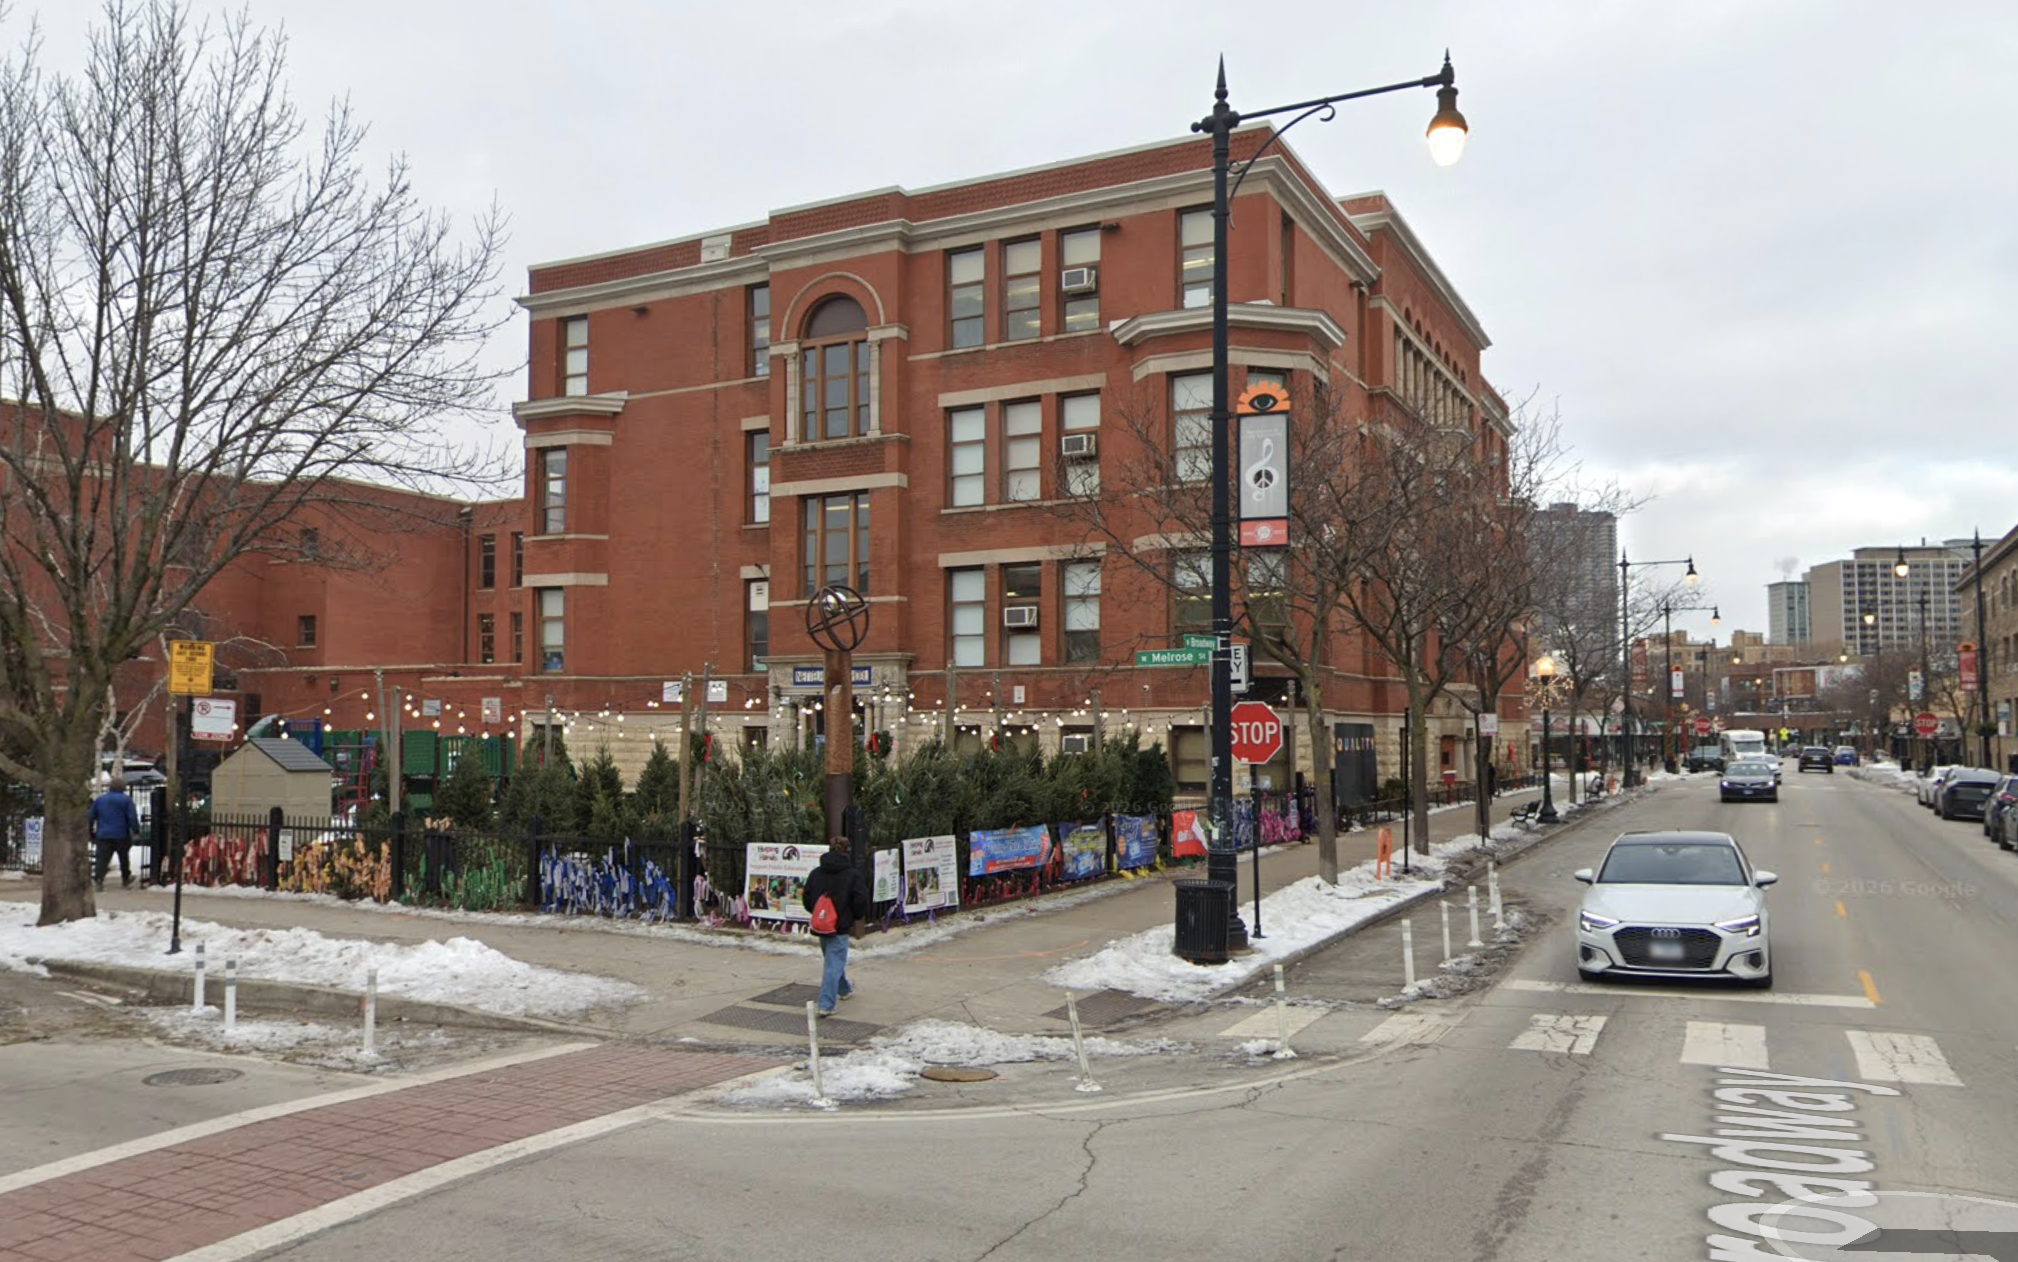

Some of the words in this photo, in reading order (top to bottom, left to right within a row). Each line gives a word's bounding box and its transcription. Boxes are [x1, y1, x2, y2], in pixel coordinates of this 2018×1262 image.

[1190, 637, 1216, 650] Broadway
[1152, 652, 1194, 663] Melrose
[1916, 718, 1938, 727] STOP
[1231, 721, 1278, 745] STOP
[1336, 737, 1374, 752] QUALITY
[28, 821, 41, 833] NO
